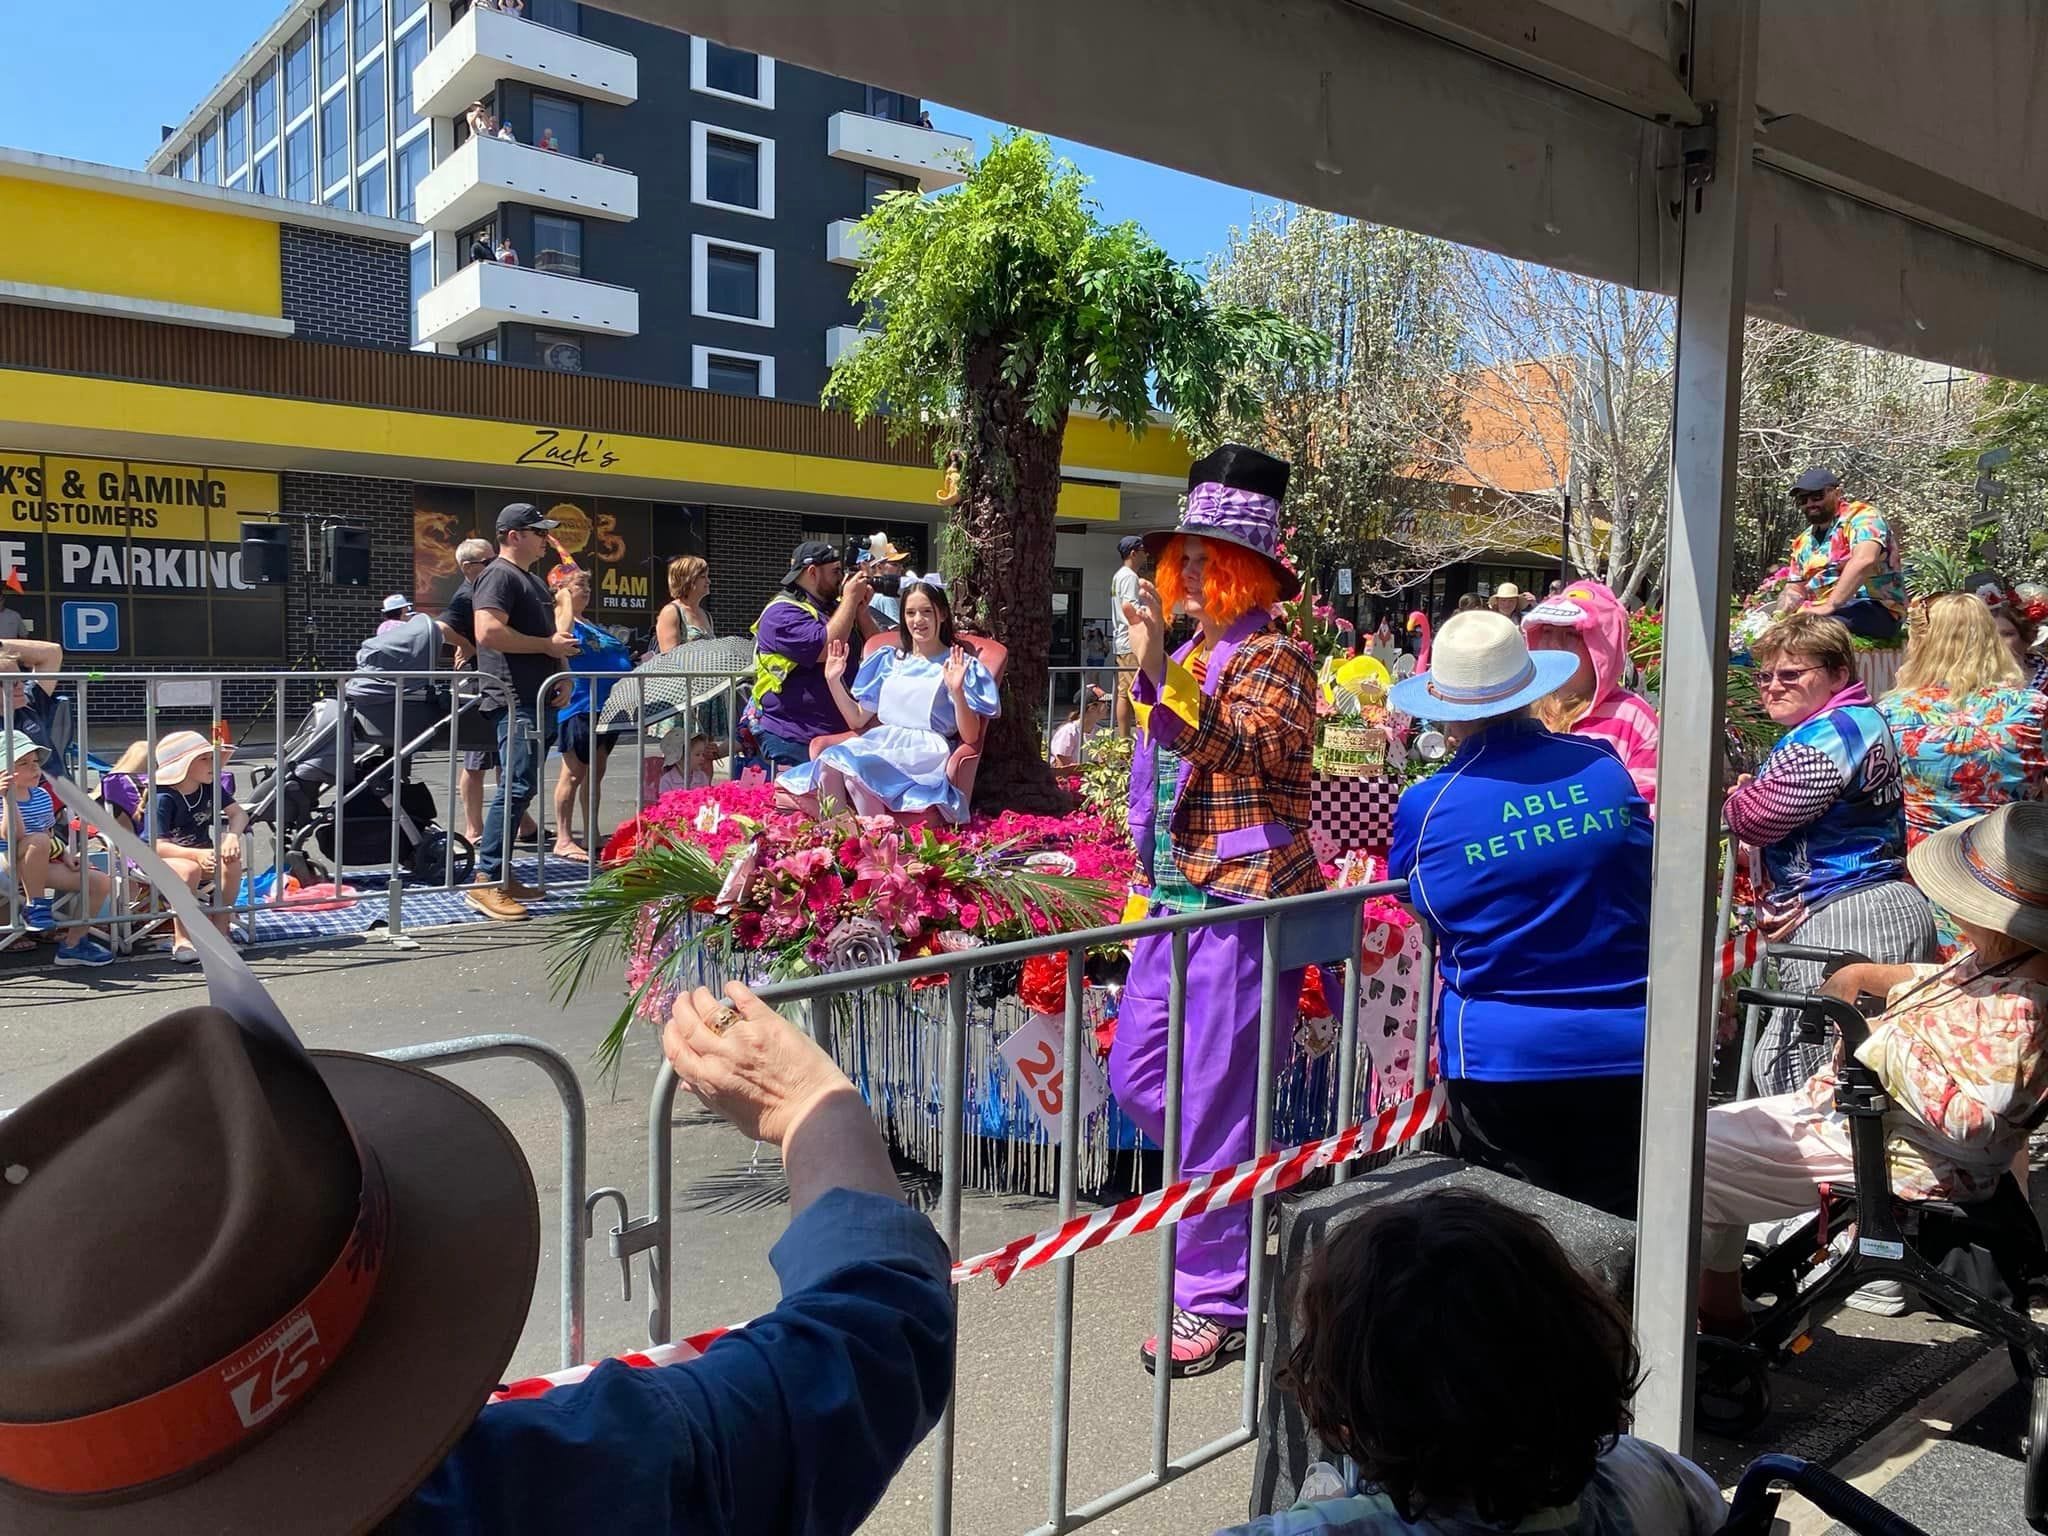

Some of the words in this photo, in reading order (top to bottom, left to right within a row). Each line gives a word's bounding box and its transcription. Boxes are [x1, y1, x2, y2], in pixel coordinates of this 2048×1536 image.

[515, 429, 620, 468] Zack's
[60, 469, 86, 499] &
[98, 472, 227, 509] GAMING
[12, 500, 159, 529] CUSTOMERS
[601, 567, 648, 596] 4AM
[603, 597, 618, 608] FRI
[620, 597, 628, 608] &
[630, 598, 647, 609] SAT
[76, 607, 109, 645] P
[1502, 783, 1590, 823] ABLE
[1464, 806, 1633, 865] RETREATS
